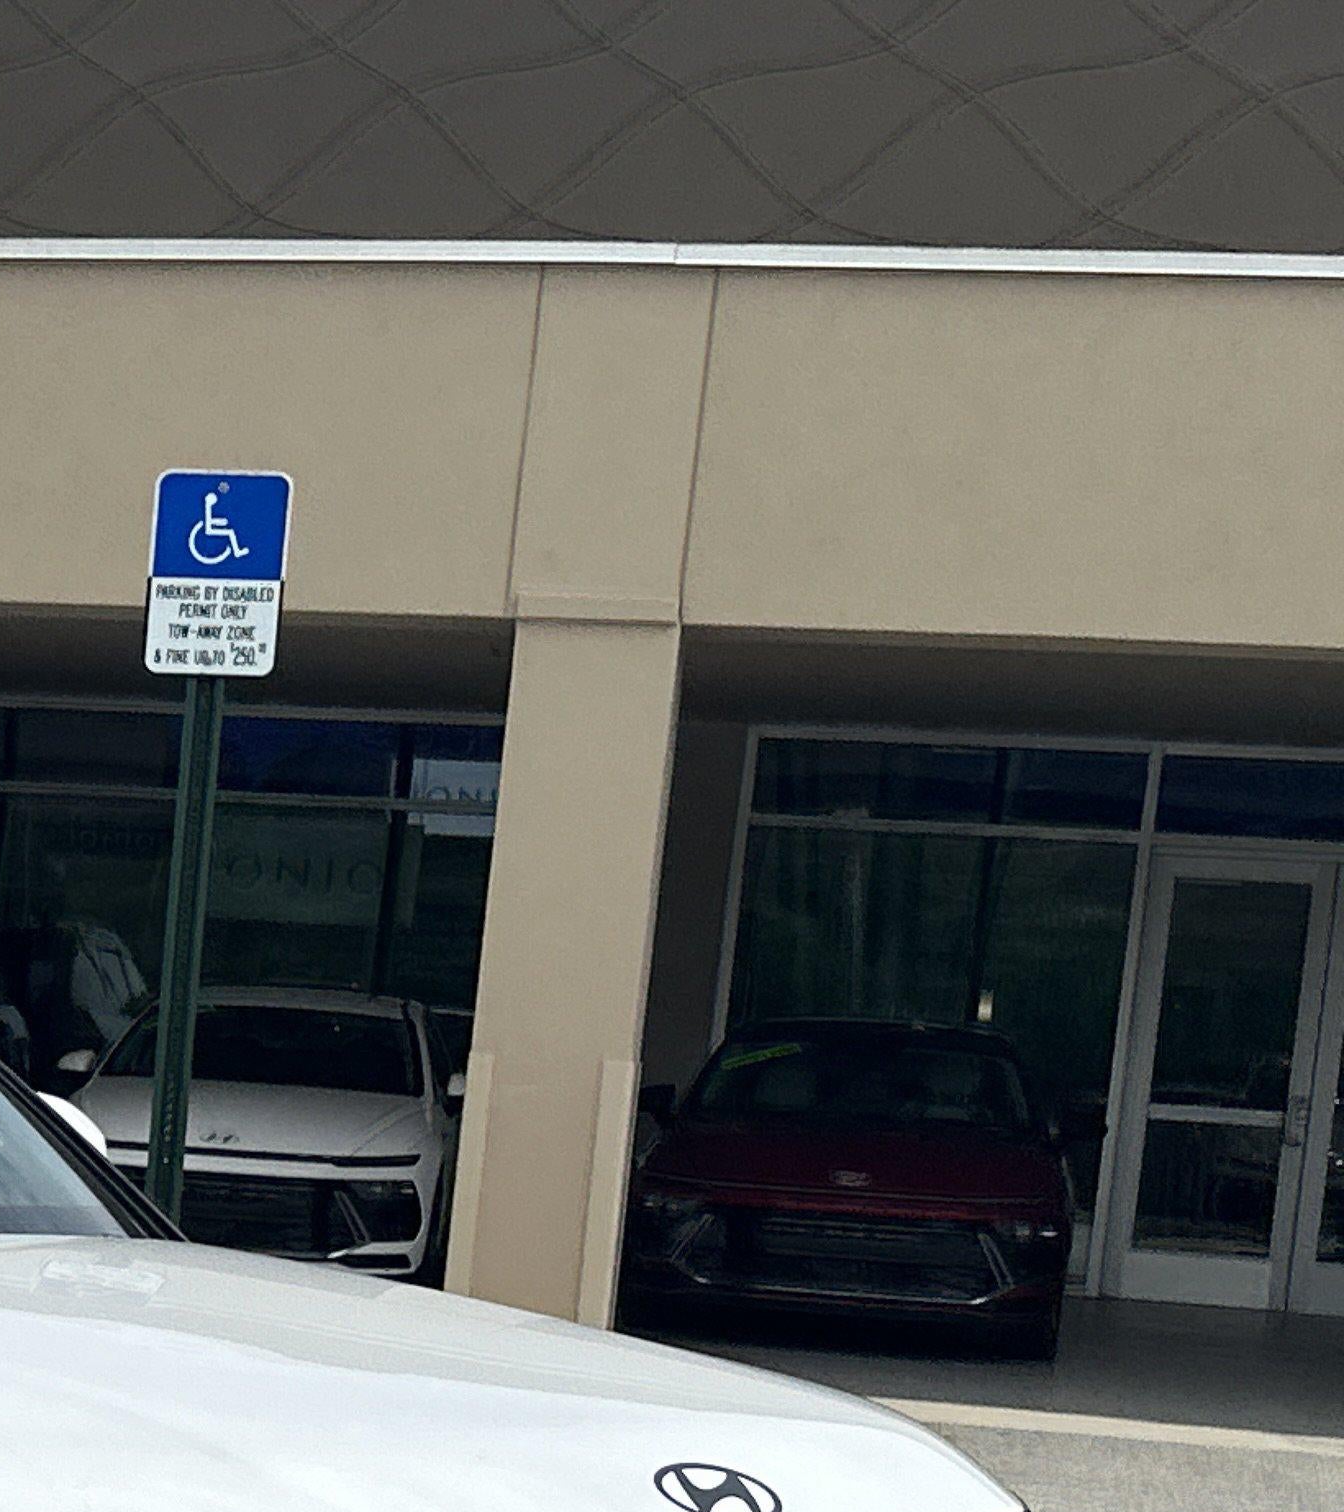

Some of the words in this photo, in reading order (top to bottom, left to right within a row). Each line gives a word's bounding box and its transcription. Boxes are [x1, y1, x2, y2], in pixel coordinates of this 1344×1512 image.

[155, 583, 201, 600] PARKING
[204, 585, 220, 601] BY
[222, 586, 275, 602] DISABLED
[178, 602, 218, 619] PERMIT
[220, 603, 248, 620] ONLY
[168, 623, 223, 639] TOW-AWAY
[226, 625, 256, 641] ZONE
[166, 648, 190, 664] FINE
